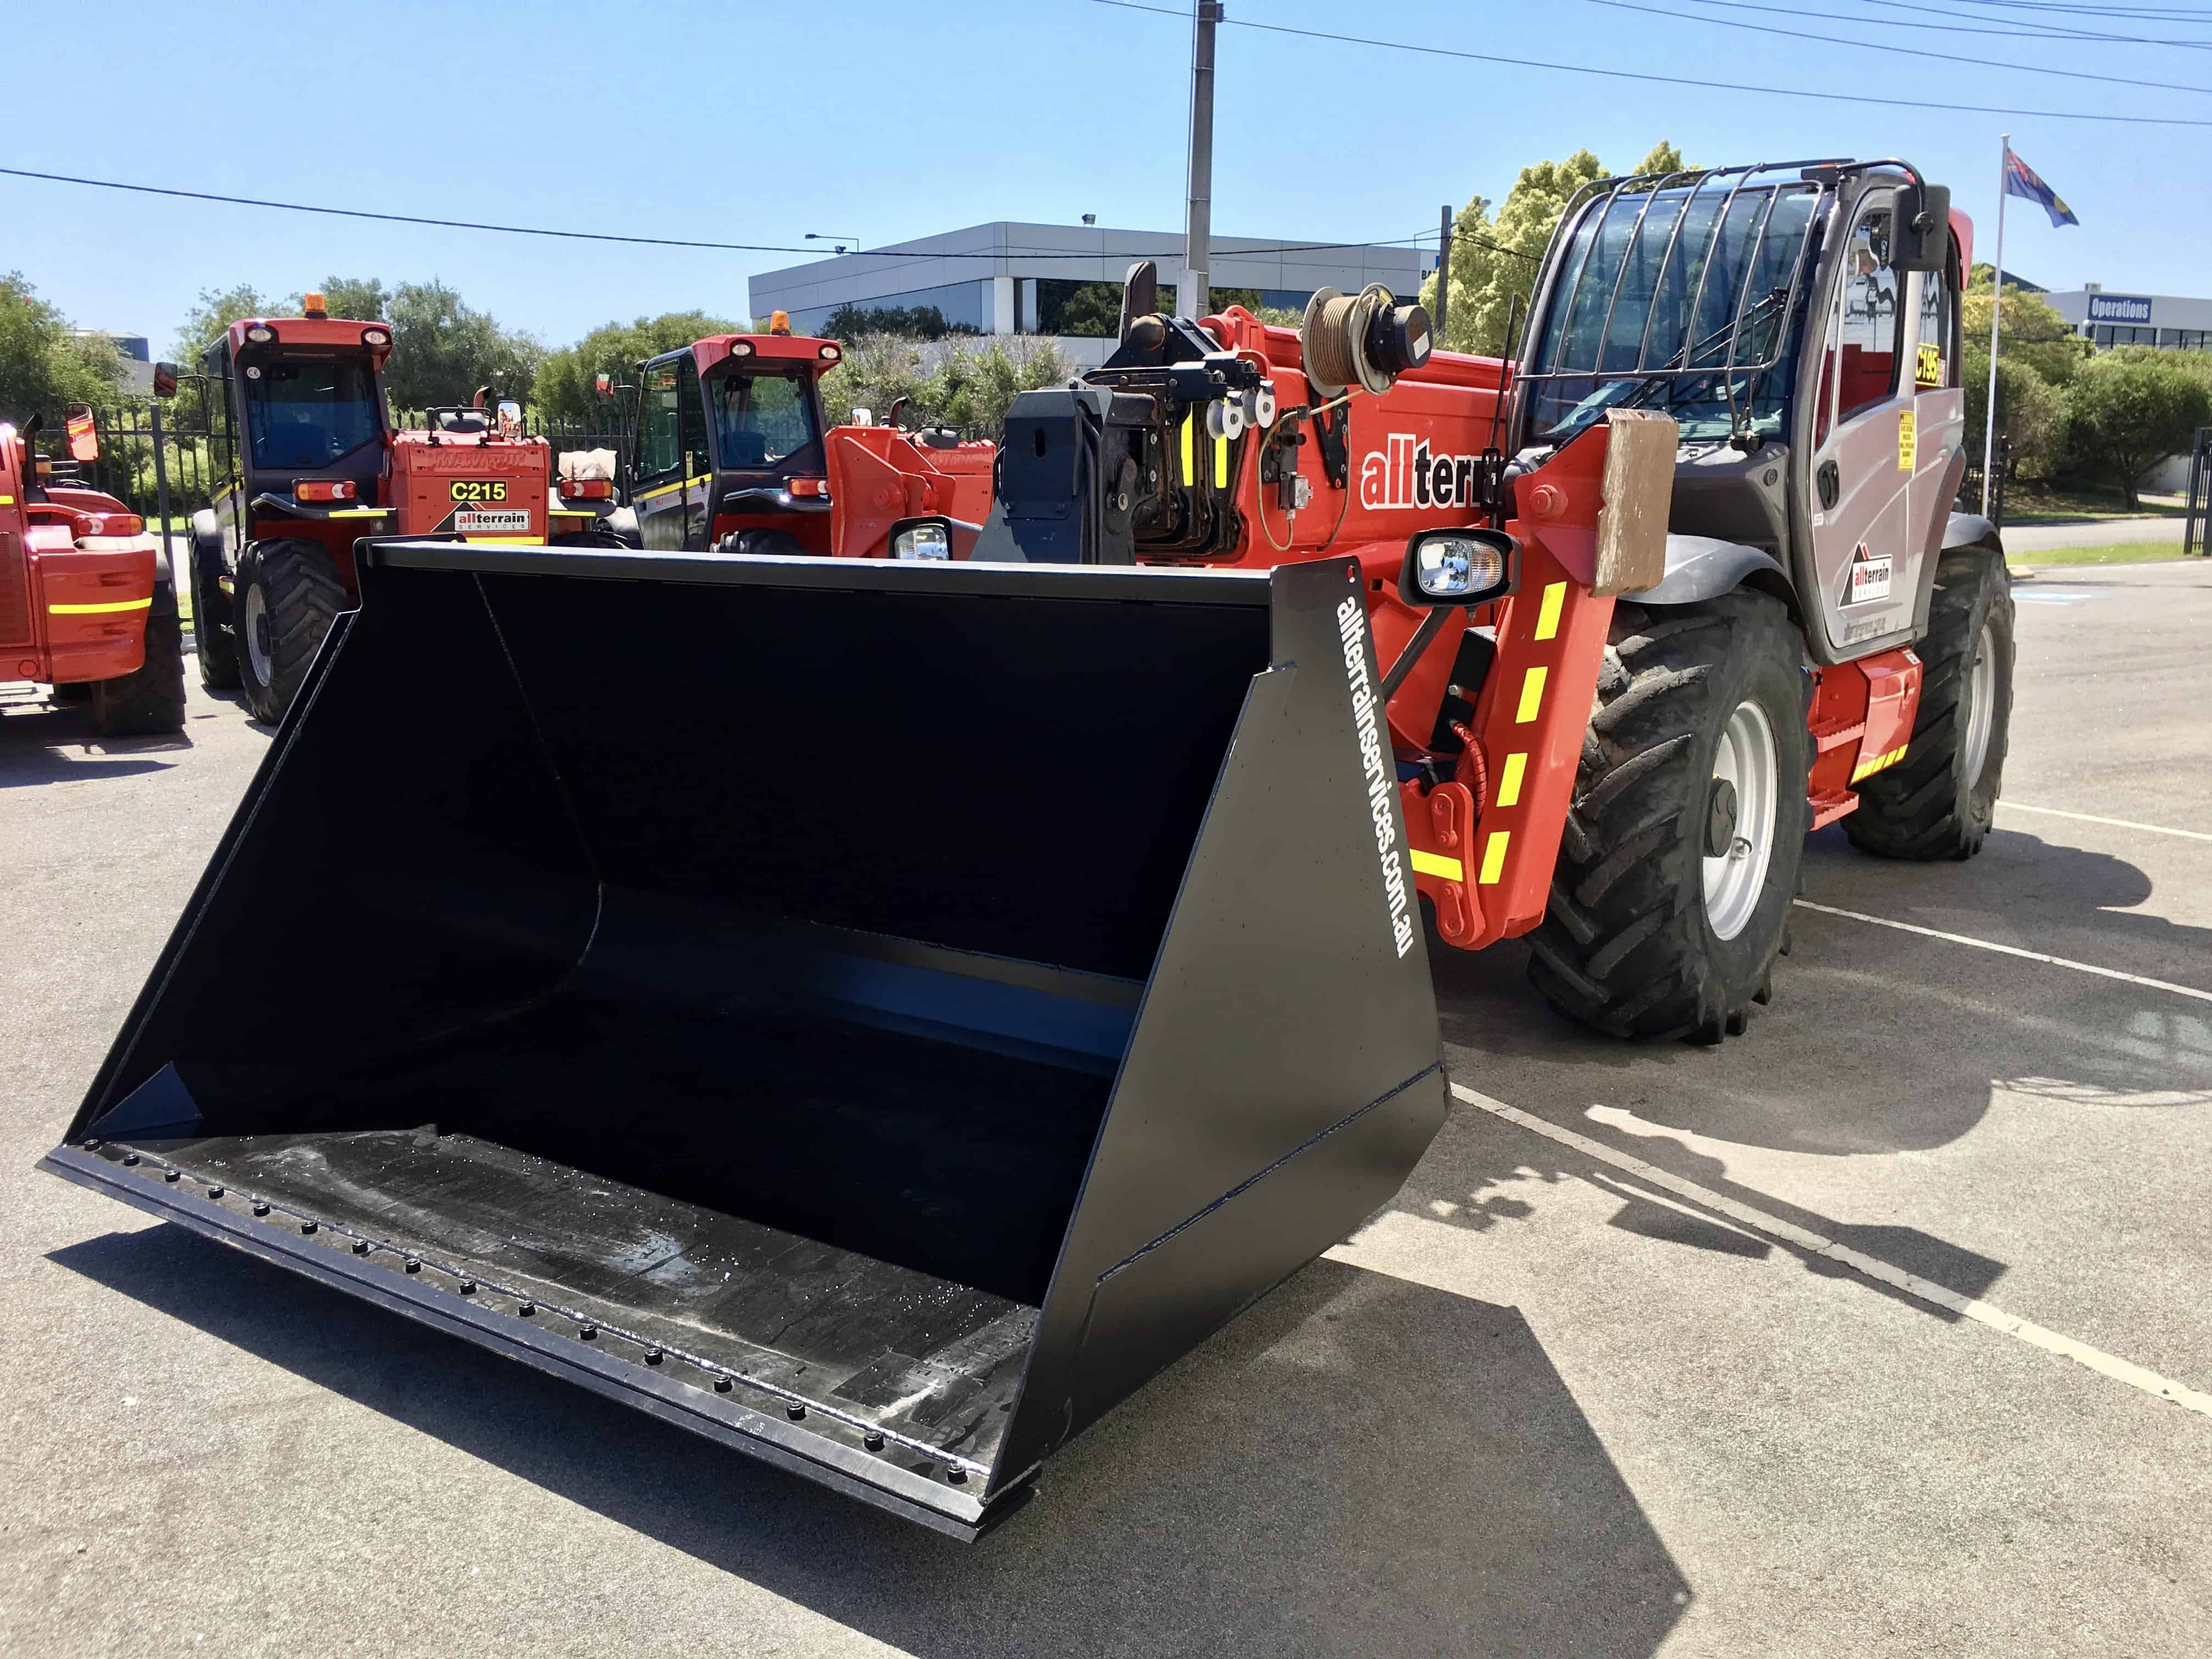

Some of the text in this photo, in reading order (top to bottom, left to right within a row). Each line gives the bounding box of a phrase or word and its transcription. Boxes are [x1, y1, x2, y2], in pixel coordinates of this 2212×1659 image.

[1421, 270, 1437, 280] BA
[2092, 297, 2148, 319] Operations
[1915, 347, 1937, 381] C195
[452, 482, 505, 500] C215
[459, 513, 525, 524] allterrain
[1855, 562, 1889, 586] allterrain
[1337, 596, 1414, 960] allterrainservices.com.au
